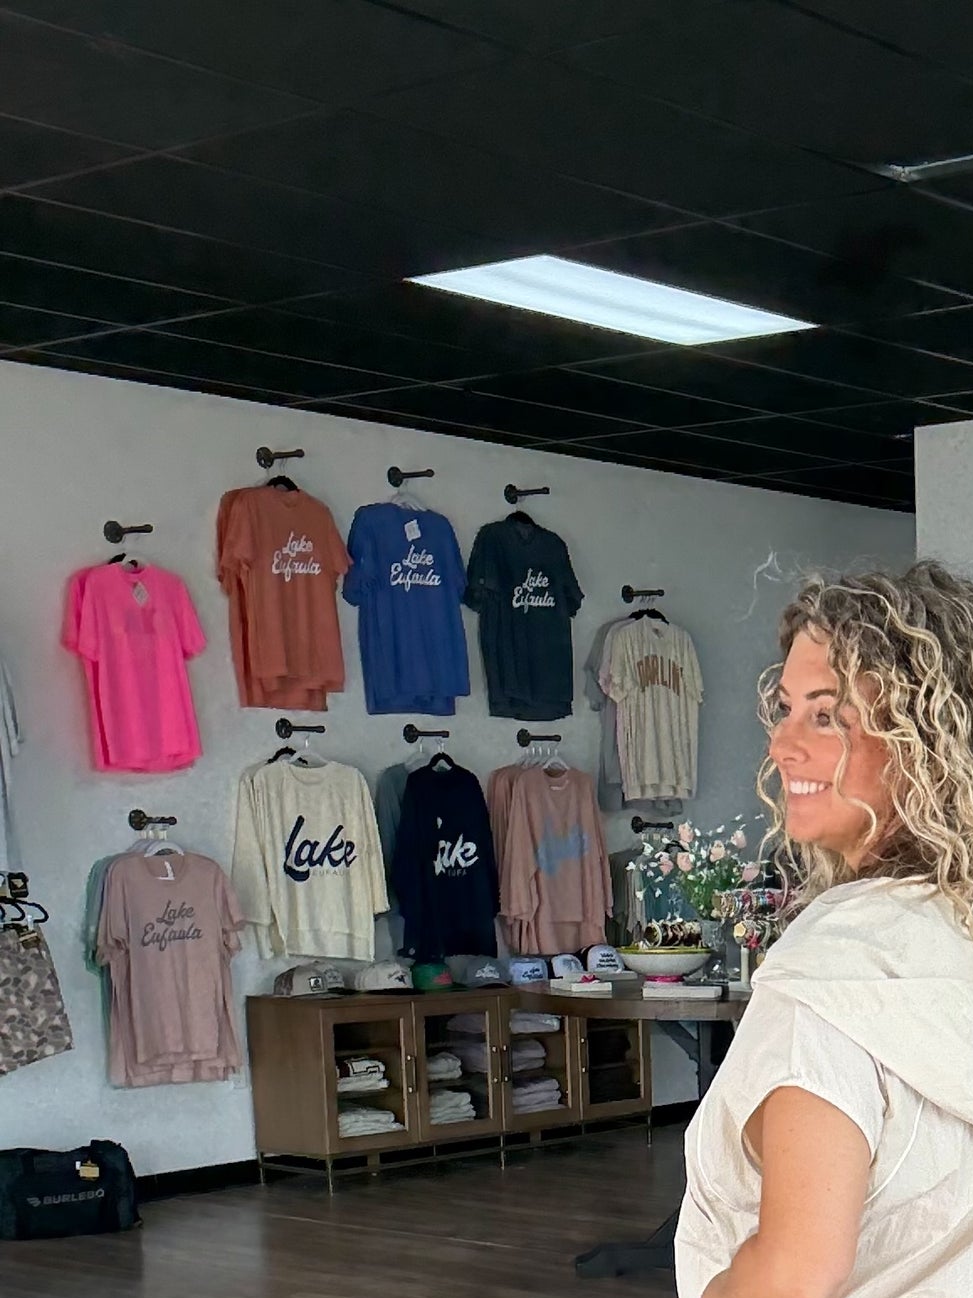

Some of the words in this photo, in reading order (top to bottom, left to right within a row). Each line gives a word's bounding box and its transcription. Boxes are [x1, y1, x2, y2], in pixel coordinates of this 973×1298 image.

[282, 531, 314, 557] Lake
[402, 544, 435, 569] Lake
[390, 562, 441, 592] Eufaula
[522, 568, 550, 592] Lake
[512, 586, 556, 614] Eufaula
[284, 815, 358, 882] Lake
[156, 900, 196, 926] Lake
[141, 922, 203, 951] Eufaula
[43, 1188, 105, 1205] BURLEBO
